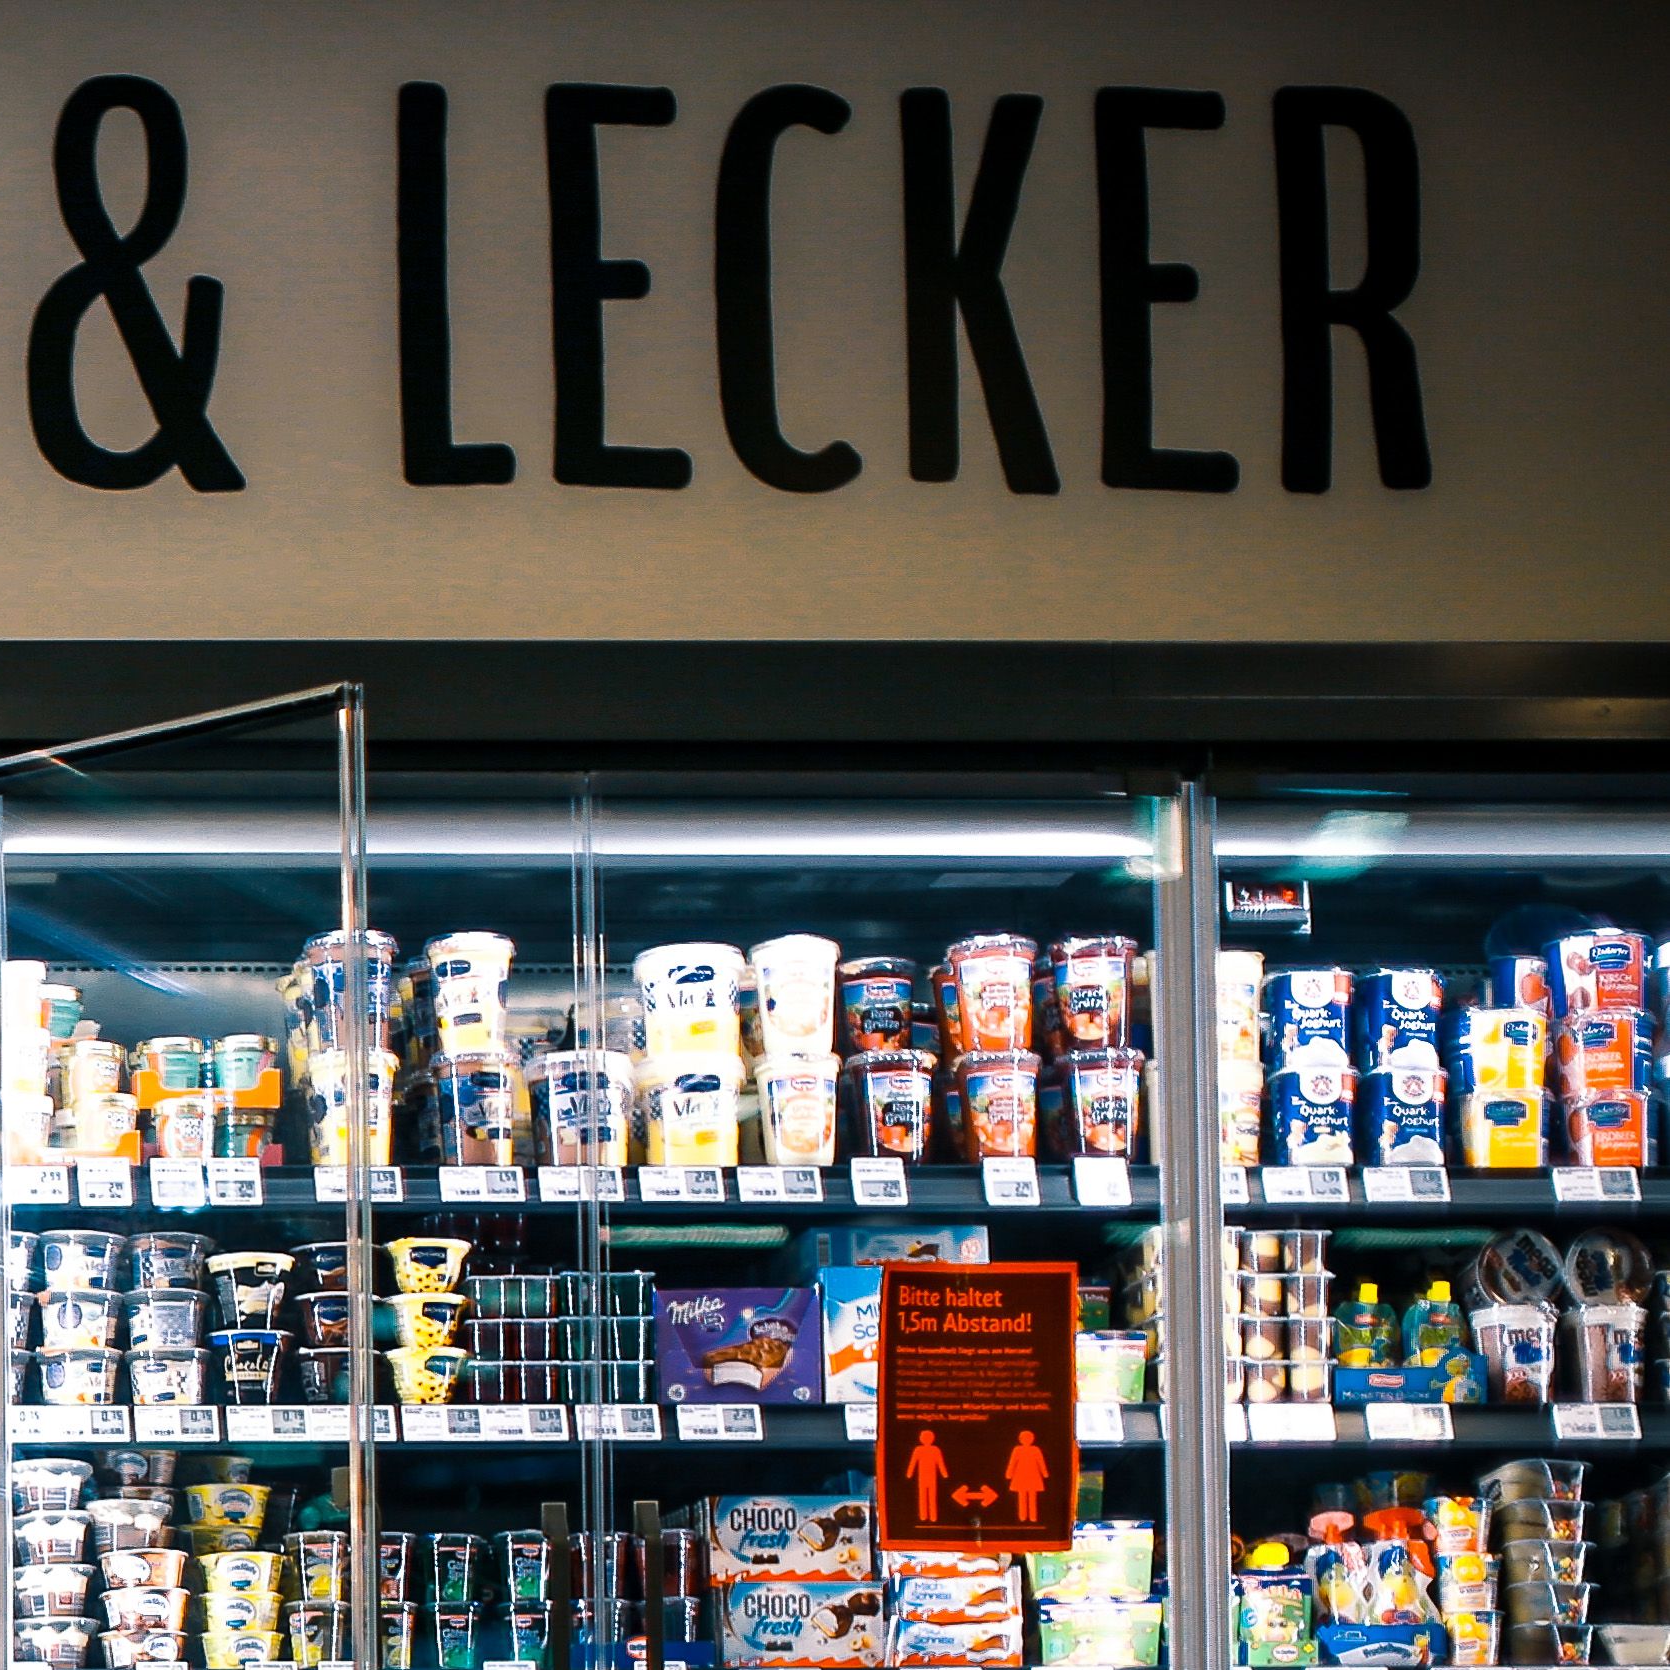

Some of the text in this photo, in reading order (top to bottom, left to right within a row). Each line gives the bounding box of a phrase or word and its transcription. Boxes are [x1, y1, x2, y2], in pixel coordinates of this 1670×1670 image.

[28, 74, 245, 494] &
[400, 83, 1431, 497] LECKER
[1299, 1018, 1342, 1030] Joghurt
[1299, 1105, 1339, 1117] Quark-
[1308, 1114, 1349, 1127] Joghurt
[1392, 1105, 1430, 1117] Quark-
[1400, 1115, 1440, 1127] Joghurt
[899, 1286, 1003, 1307] Bitte haltet
[667, 1296, 725, 1325] Milka
[898, 1311, 1032, 1334] 1,5m Abstand!
[224, 1354, 271, 1373] Chocola
[730, 1507, 797, 1532] CHOCO
[740, 1529, 791, 1550] fresh
[744, 1593, 811, 1618] CHOCO
[752, 1616, 804, 1638] fresh
